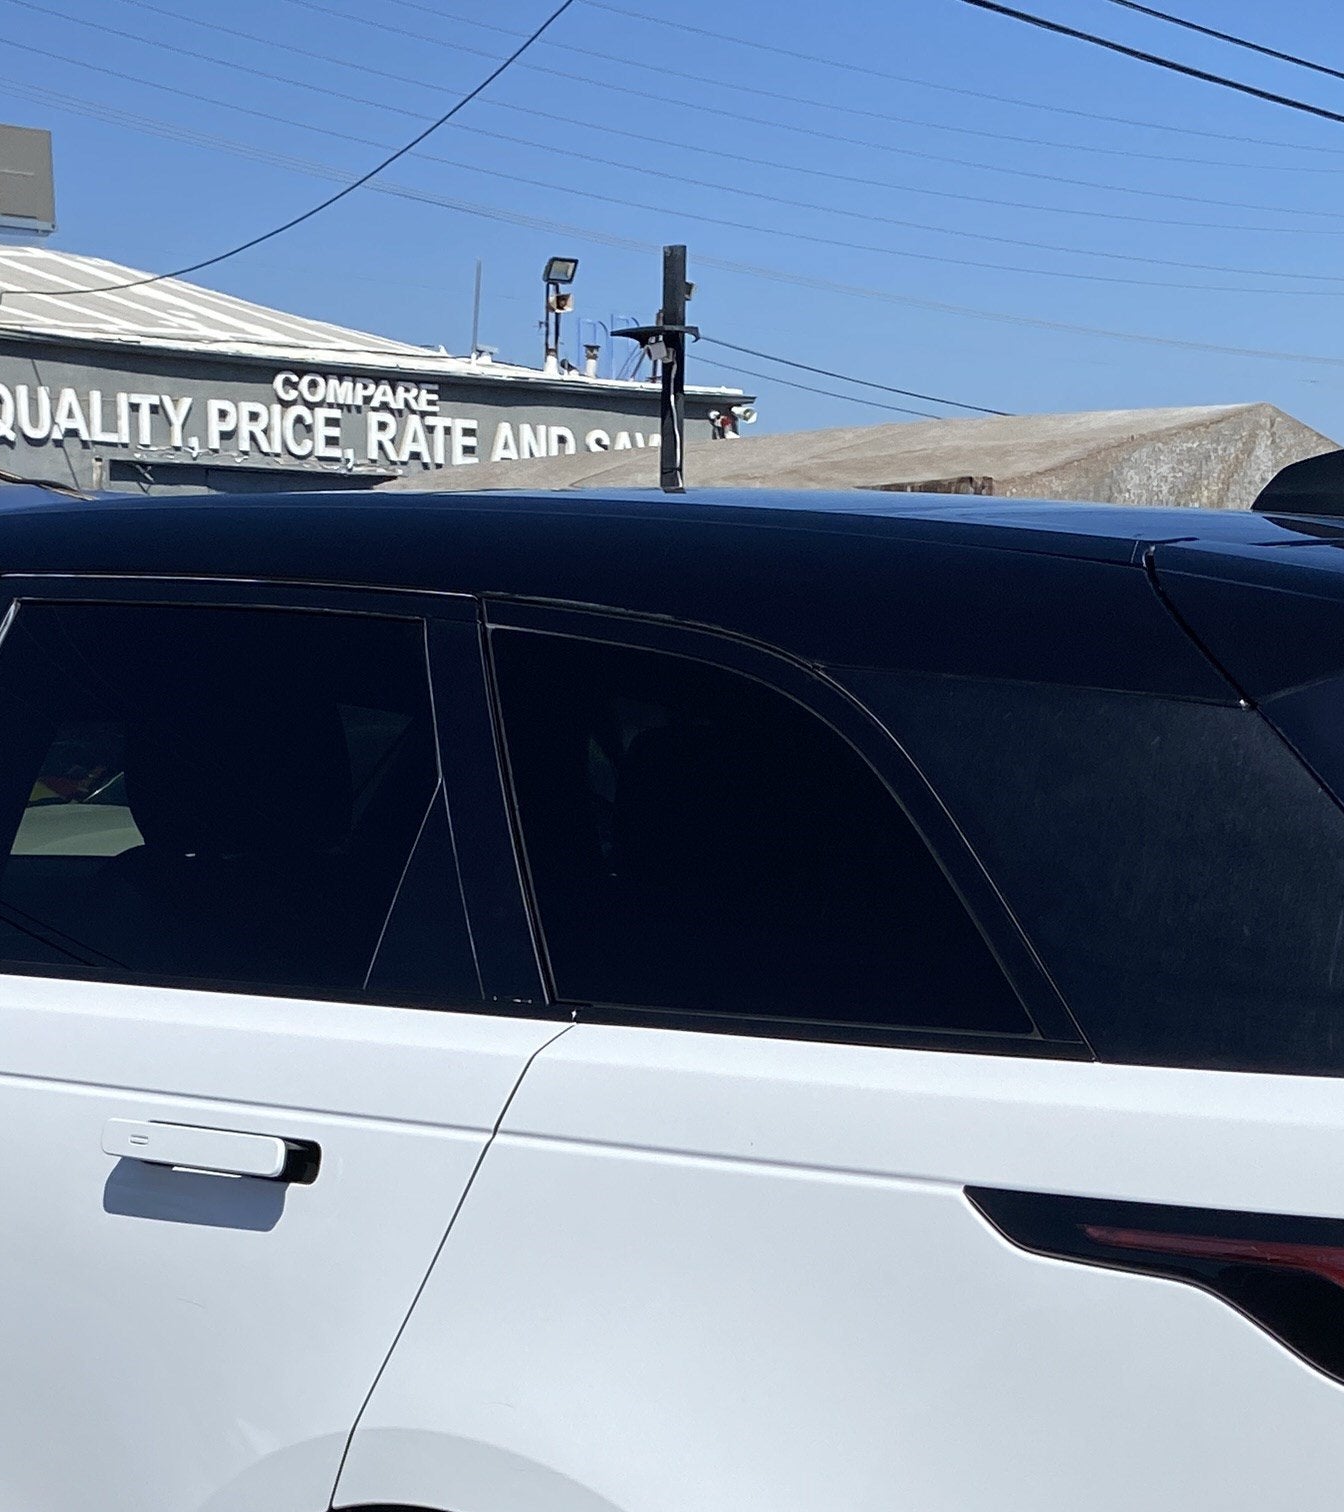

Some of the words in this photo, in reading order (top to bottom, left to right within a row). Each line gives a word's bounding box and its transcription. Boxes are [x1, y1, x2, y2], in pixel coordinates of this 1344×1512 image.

[272, 370, 440, 412] COMPARE
[207, 399, 354, 469] PRICE,
[366, 410, 479, 466] RATE
[490, 421, 576, 463] AND
